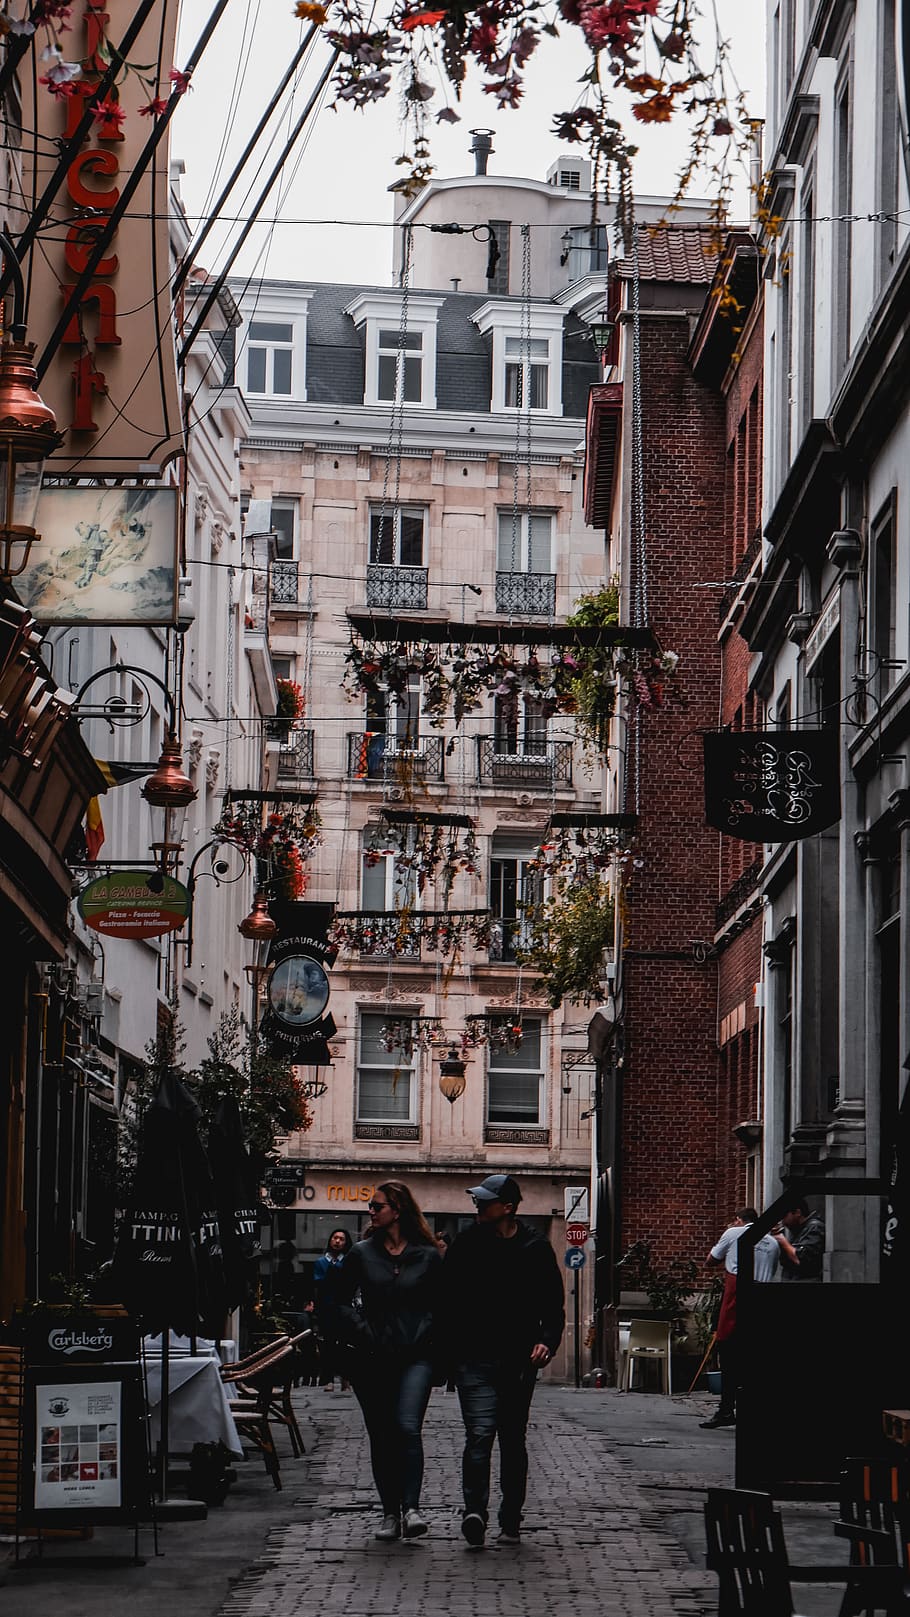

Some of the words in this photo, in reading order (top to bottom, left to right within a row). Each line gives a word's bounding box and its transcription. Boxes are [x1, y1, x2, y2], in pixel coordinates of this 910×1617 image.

[92, 887, 107, 899] LA
[108, 910, 127, 918] Pizza
[566, 1230, 587, 1241] STOP
[48, 1327, 113, 1356] Carlsberg
